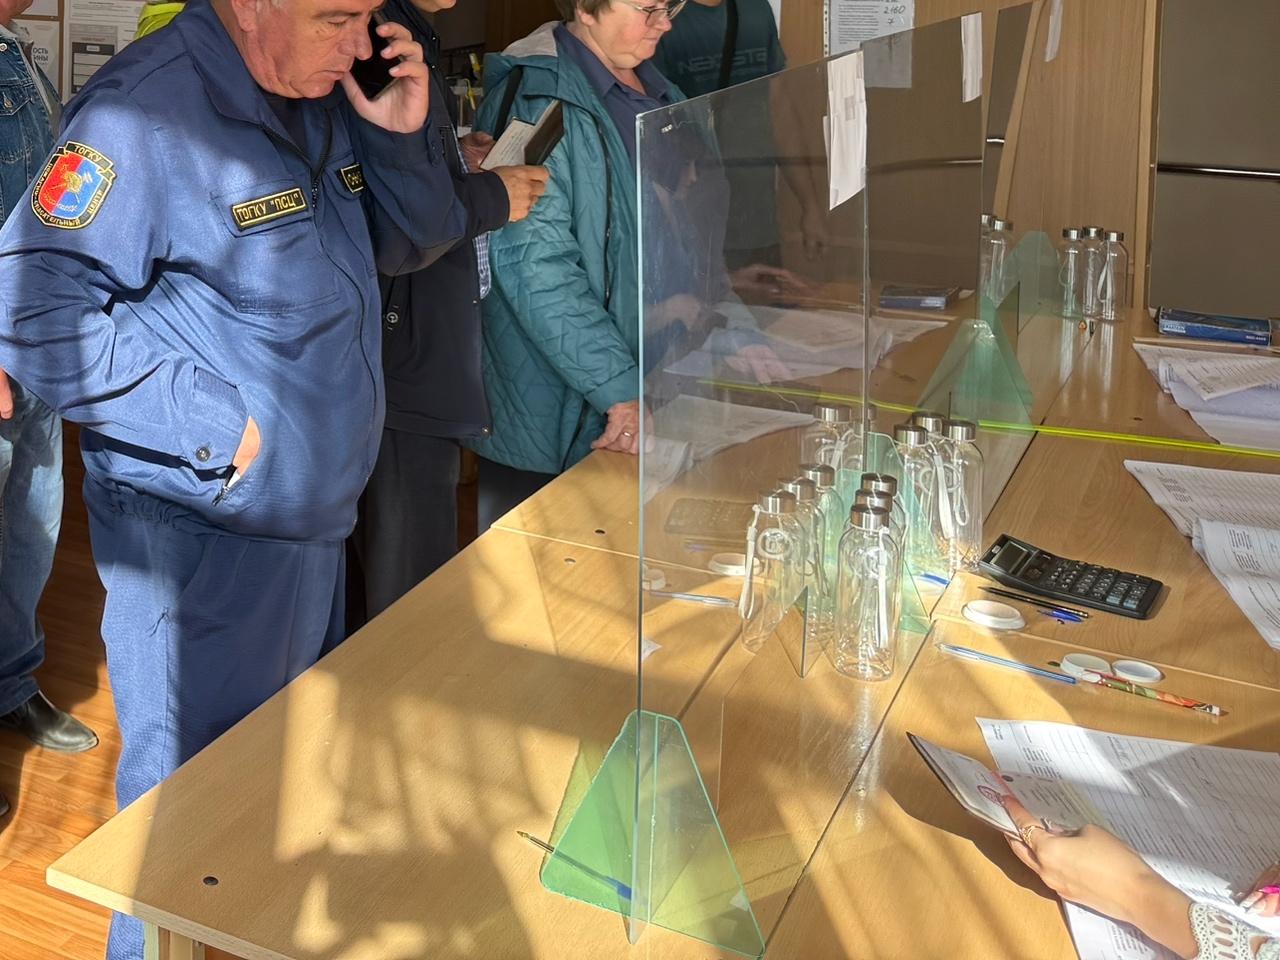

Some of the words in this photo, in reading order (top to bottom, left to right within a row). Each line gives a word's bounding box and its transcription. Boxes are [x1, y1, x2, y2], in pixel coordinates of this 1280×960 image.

[883, 5, 906, 14] 2160
[75, 145, 101, 162] ТОГКУ
[236, 203, 267, 221] ТОГКУ
[270, 192, 299, 211] "ПСЦ"
